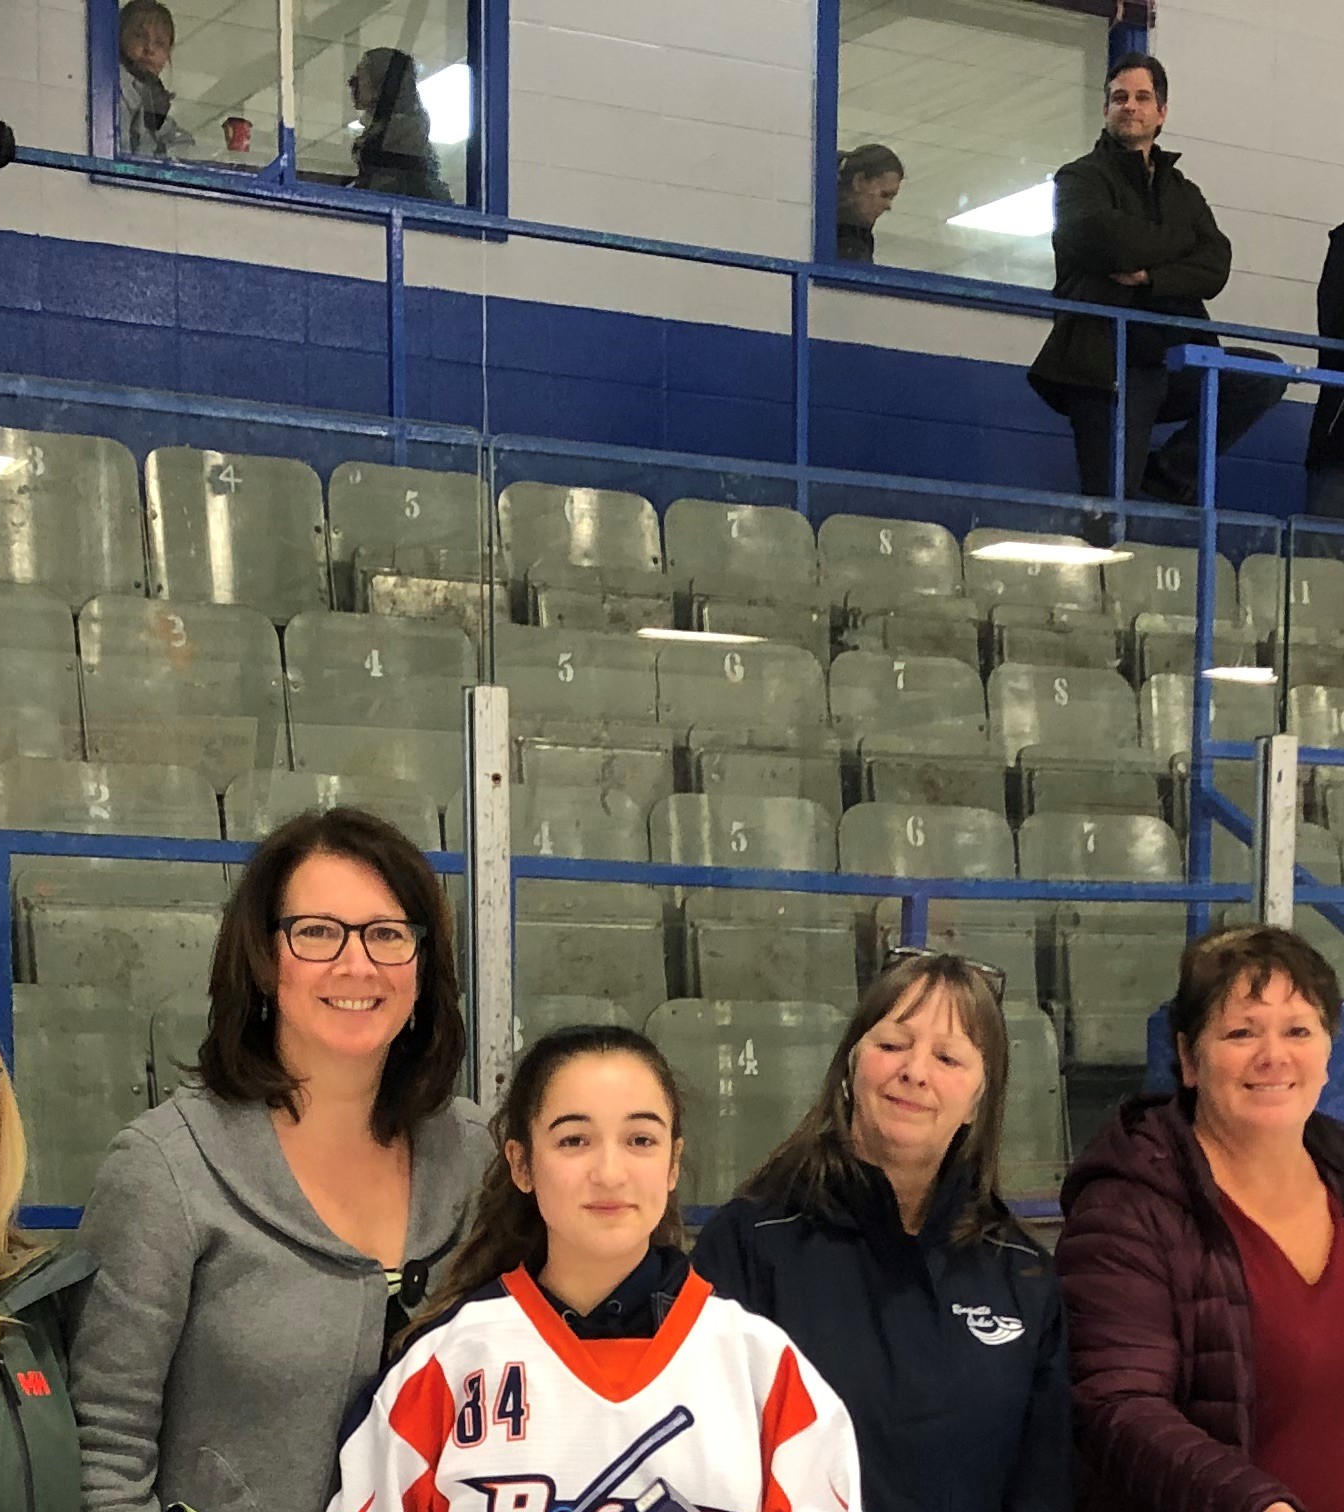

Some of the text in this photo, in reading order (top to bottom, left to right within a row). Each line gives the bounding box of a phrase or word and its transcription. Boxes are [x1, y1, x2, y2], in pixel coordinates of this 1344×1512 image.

[26, 446, 44, 477] 3
[218, 465, 243, 493] 4
[404, 490, 420, 519] 5
[726, 511, 740, 539] 7
[879, 529, 893, 556] 8
[1155, 566, 1180, 591] 10
[168, 614, 186, 647] 3
[364, 649, 382, 678] 4
[558, 653, 573, 682] 5
[723, 652, 744, 682] 6
[892, 661, 905, 690] 7
[1053, 677, 1068, 706] 8
[83, 782, 111, 819] 2
[533, 821, 553, 855] 4
[730, 821, 747, 852] 5
[906, 815, 924, 847] 6
[1083, 822, 1098, 853] 7
